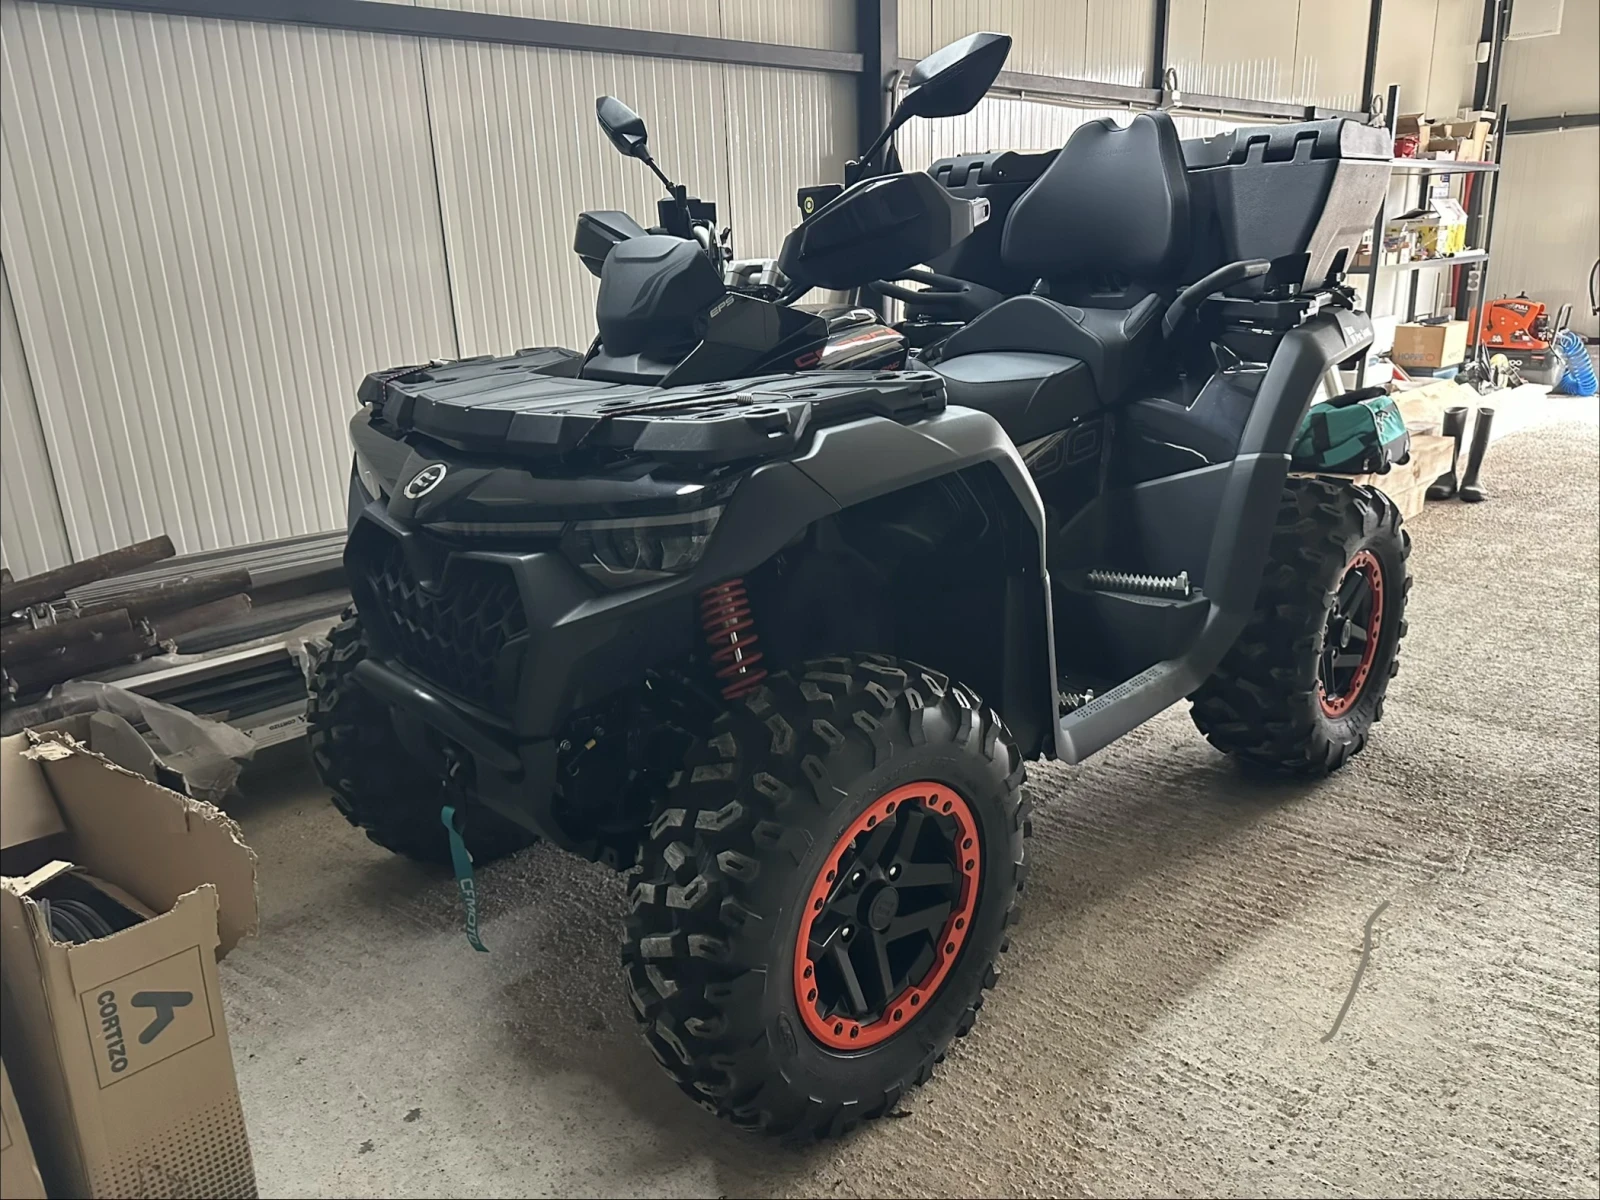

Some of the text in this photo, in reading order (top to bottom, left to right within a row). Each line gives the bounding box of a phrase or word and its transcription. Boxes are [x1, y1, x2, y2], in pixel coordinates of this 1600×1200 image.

[710, 295, 735, 318] EPS
[268, 719, 296, 731] CORTIZO
[460, 877, 479, 945] CFMOTO
[97, 990, 128, 1073] CORTIZO
